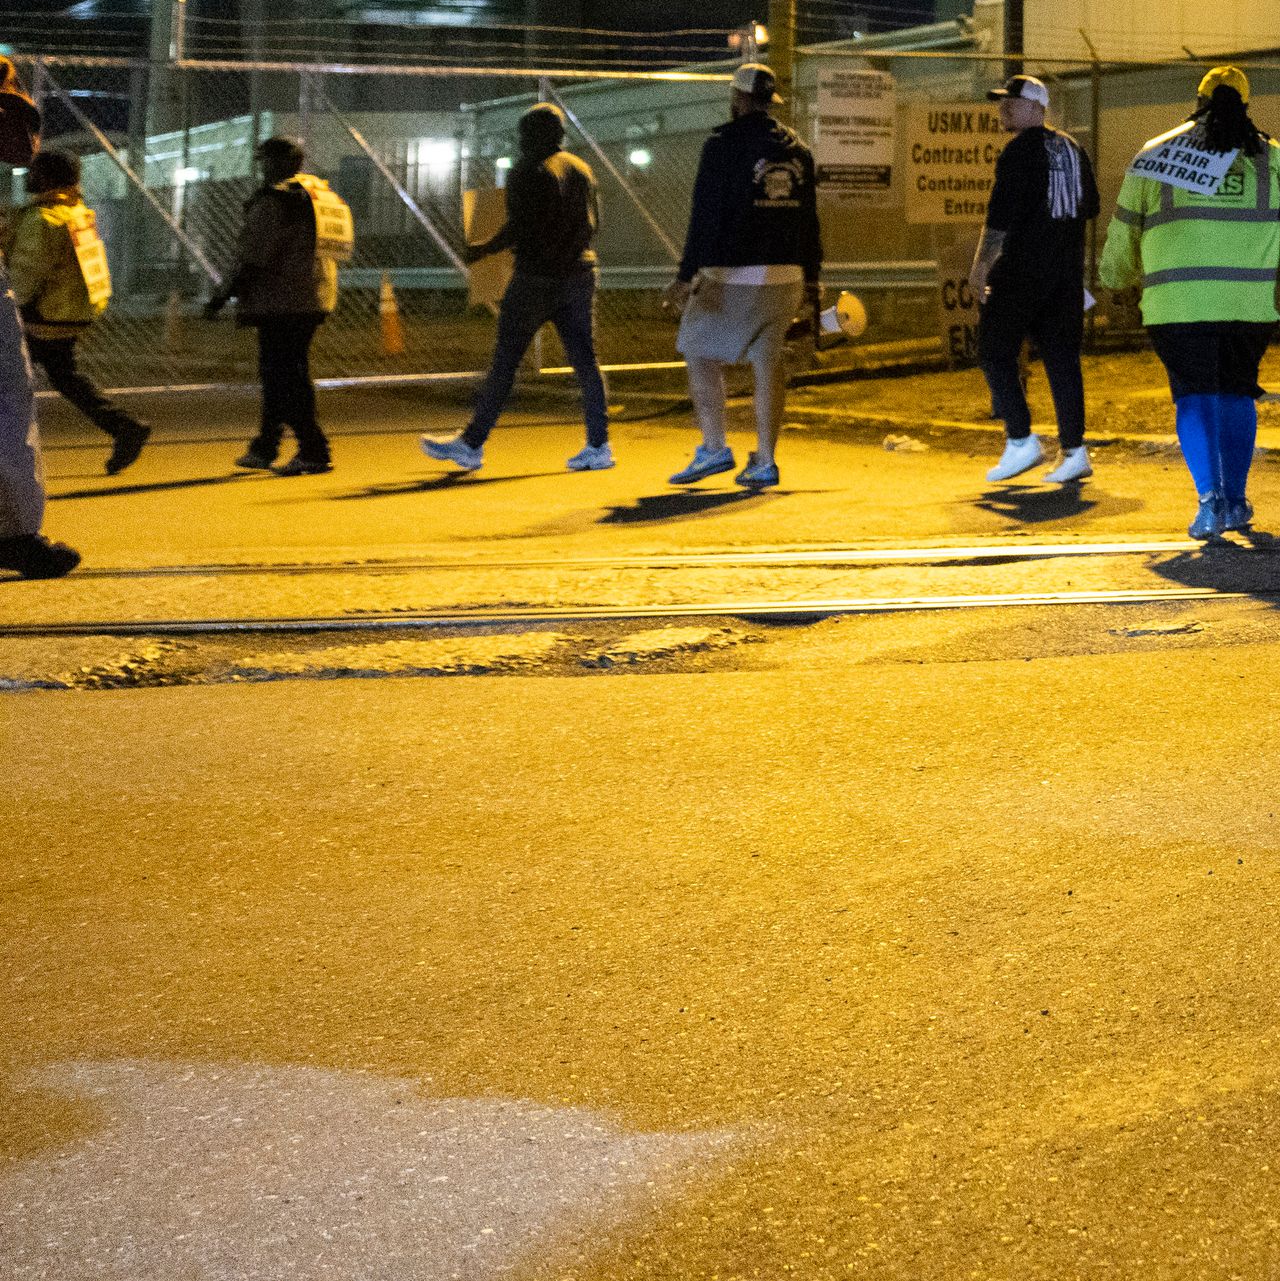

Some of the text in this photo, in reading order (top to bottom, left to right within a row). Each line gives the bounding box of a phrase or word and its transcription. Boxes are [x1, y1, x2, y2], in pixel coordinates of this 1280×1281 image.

[928, 111, 974, 134] USMX
[911, 143, 979, 165] Contract
[1158, 148, 1210, 169] A FAIR
[916, 175, 992, 192] Container
[1133, 158, 1219, 188] CONTRACT
[944, 198, 986, 216] Entra
[942, 279, 974, 311] CO
